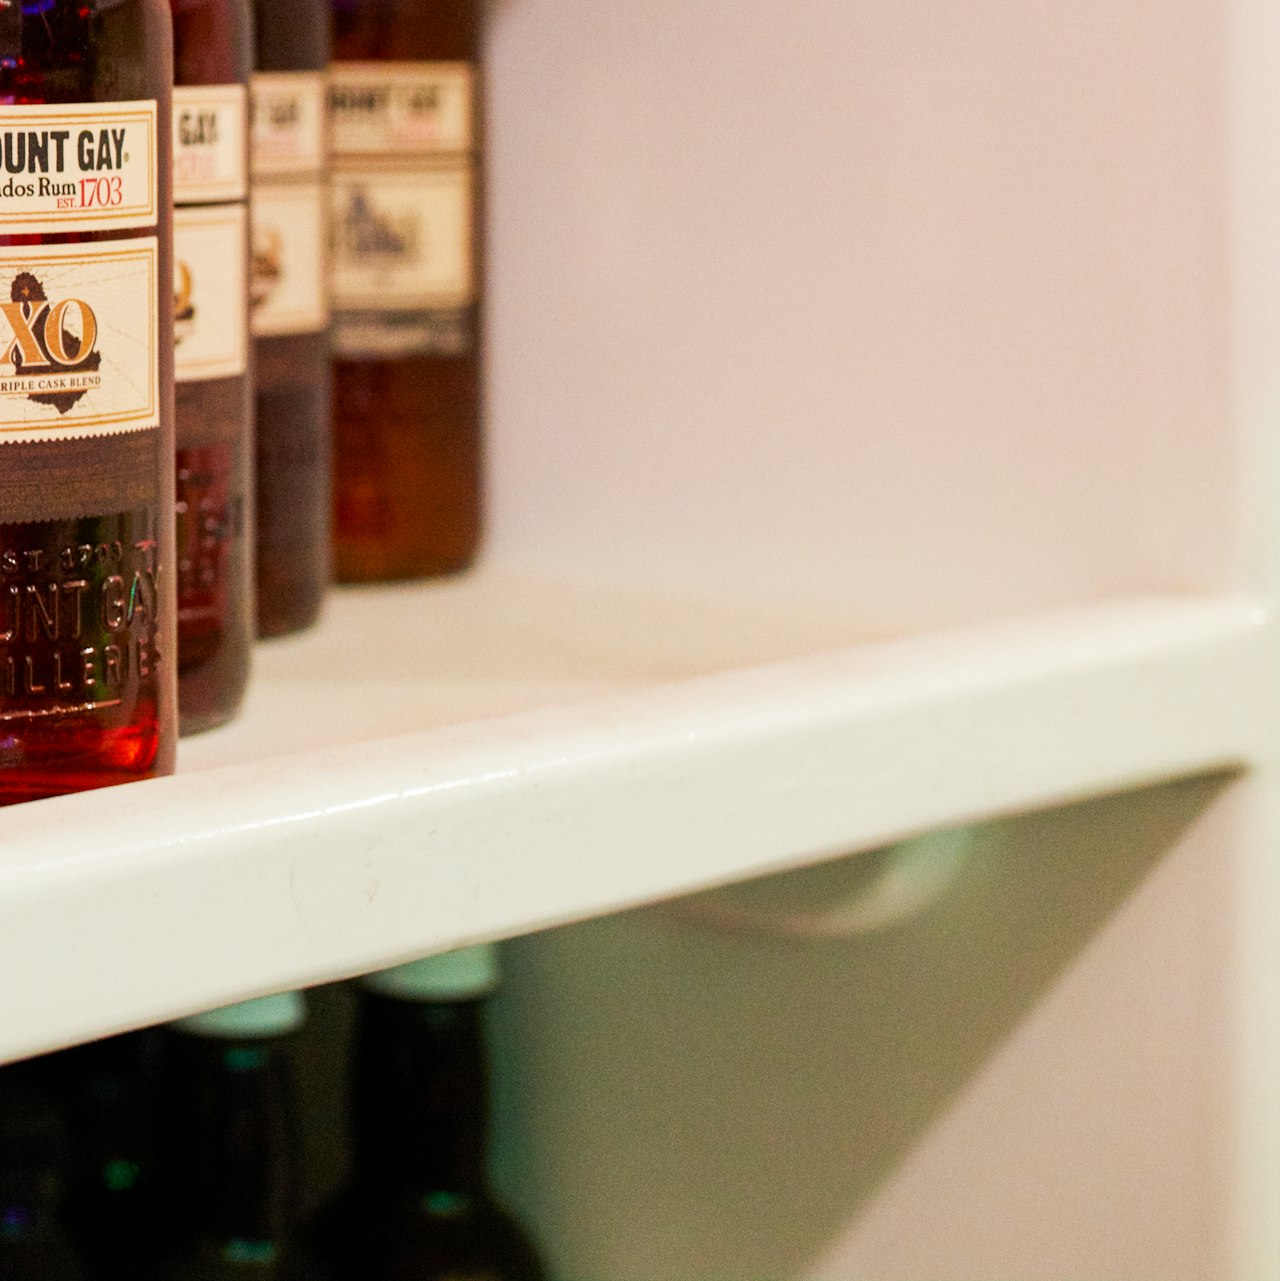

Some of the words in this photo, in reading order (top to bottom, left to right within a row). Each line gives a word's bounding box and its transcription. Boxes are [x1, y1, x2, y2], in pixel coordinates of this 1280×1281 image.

[38, 176, 77, 198] Rum
[78, 176, 123, 209] 1703
[38, 377, 68, 390] CASK
[69, 375, 102, 389] BLEND
